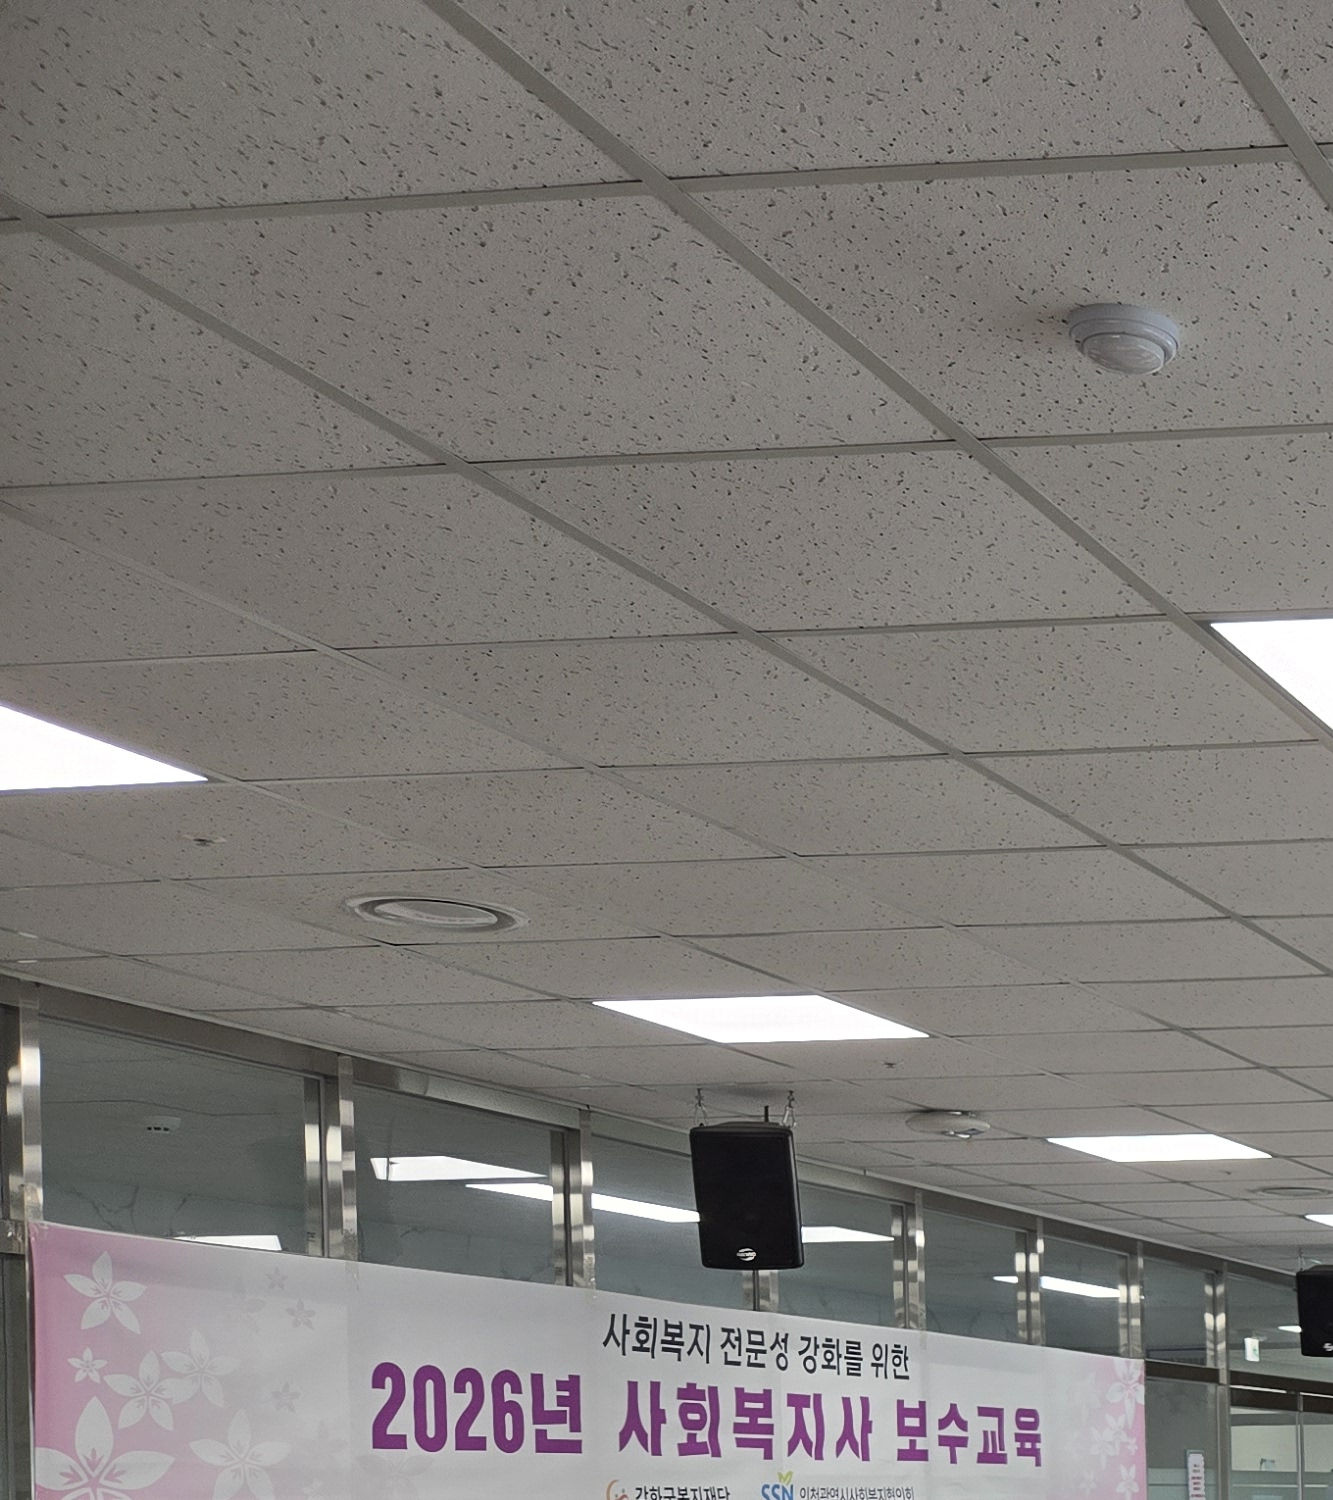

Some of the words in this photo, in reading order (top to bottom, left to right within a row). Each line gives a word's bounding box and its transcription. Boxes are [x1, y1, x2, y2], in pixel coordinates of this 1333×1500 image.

[602, 1313, 711, 1365] 사회복지
[719, 1326, 790, 1372] 전문성
[797, 1335, 864, 1377] 강화를
[870, 1342, 910, 1380] 위한
[371, 1361, 583, 1455] 2026년
[618, 1380, 873, 1462] 사회복지사
[896, 1398, 1042, 1468] 보수교육
